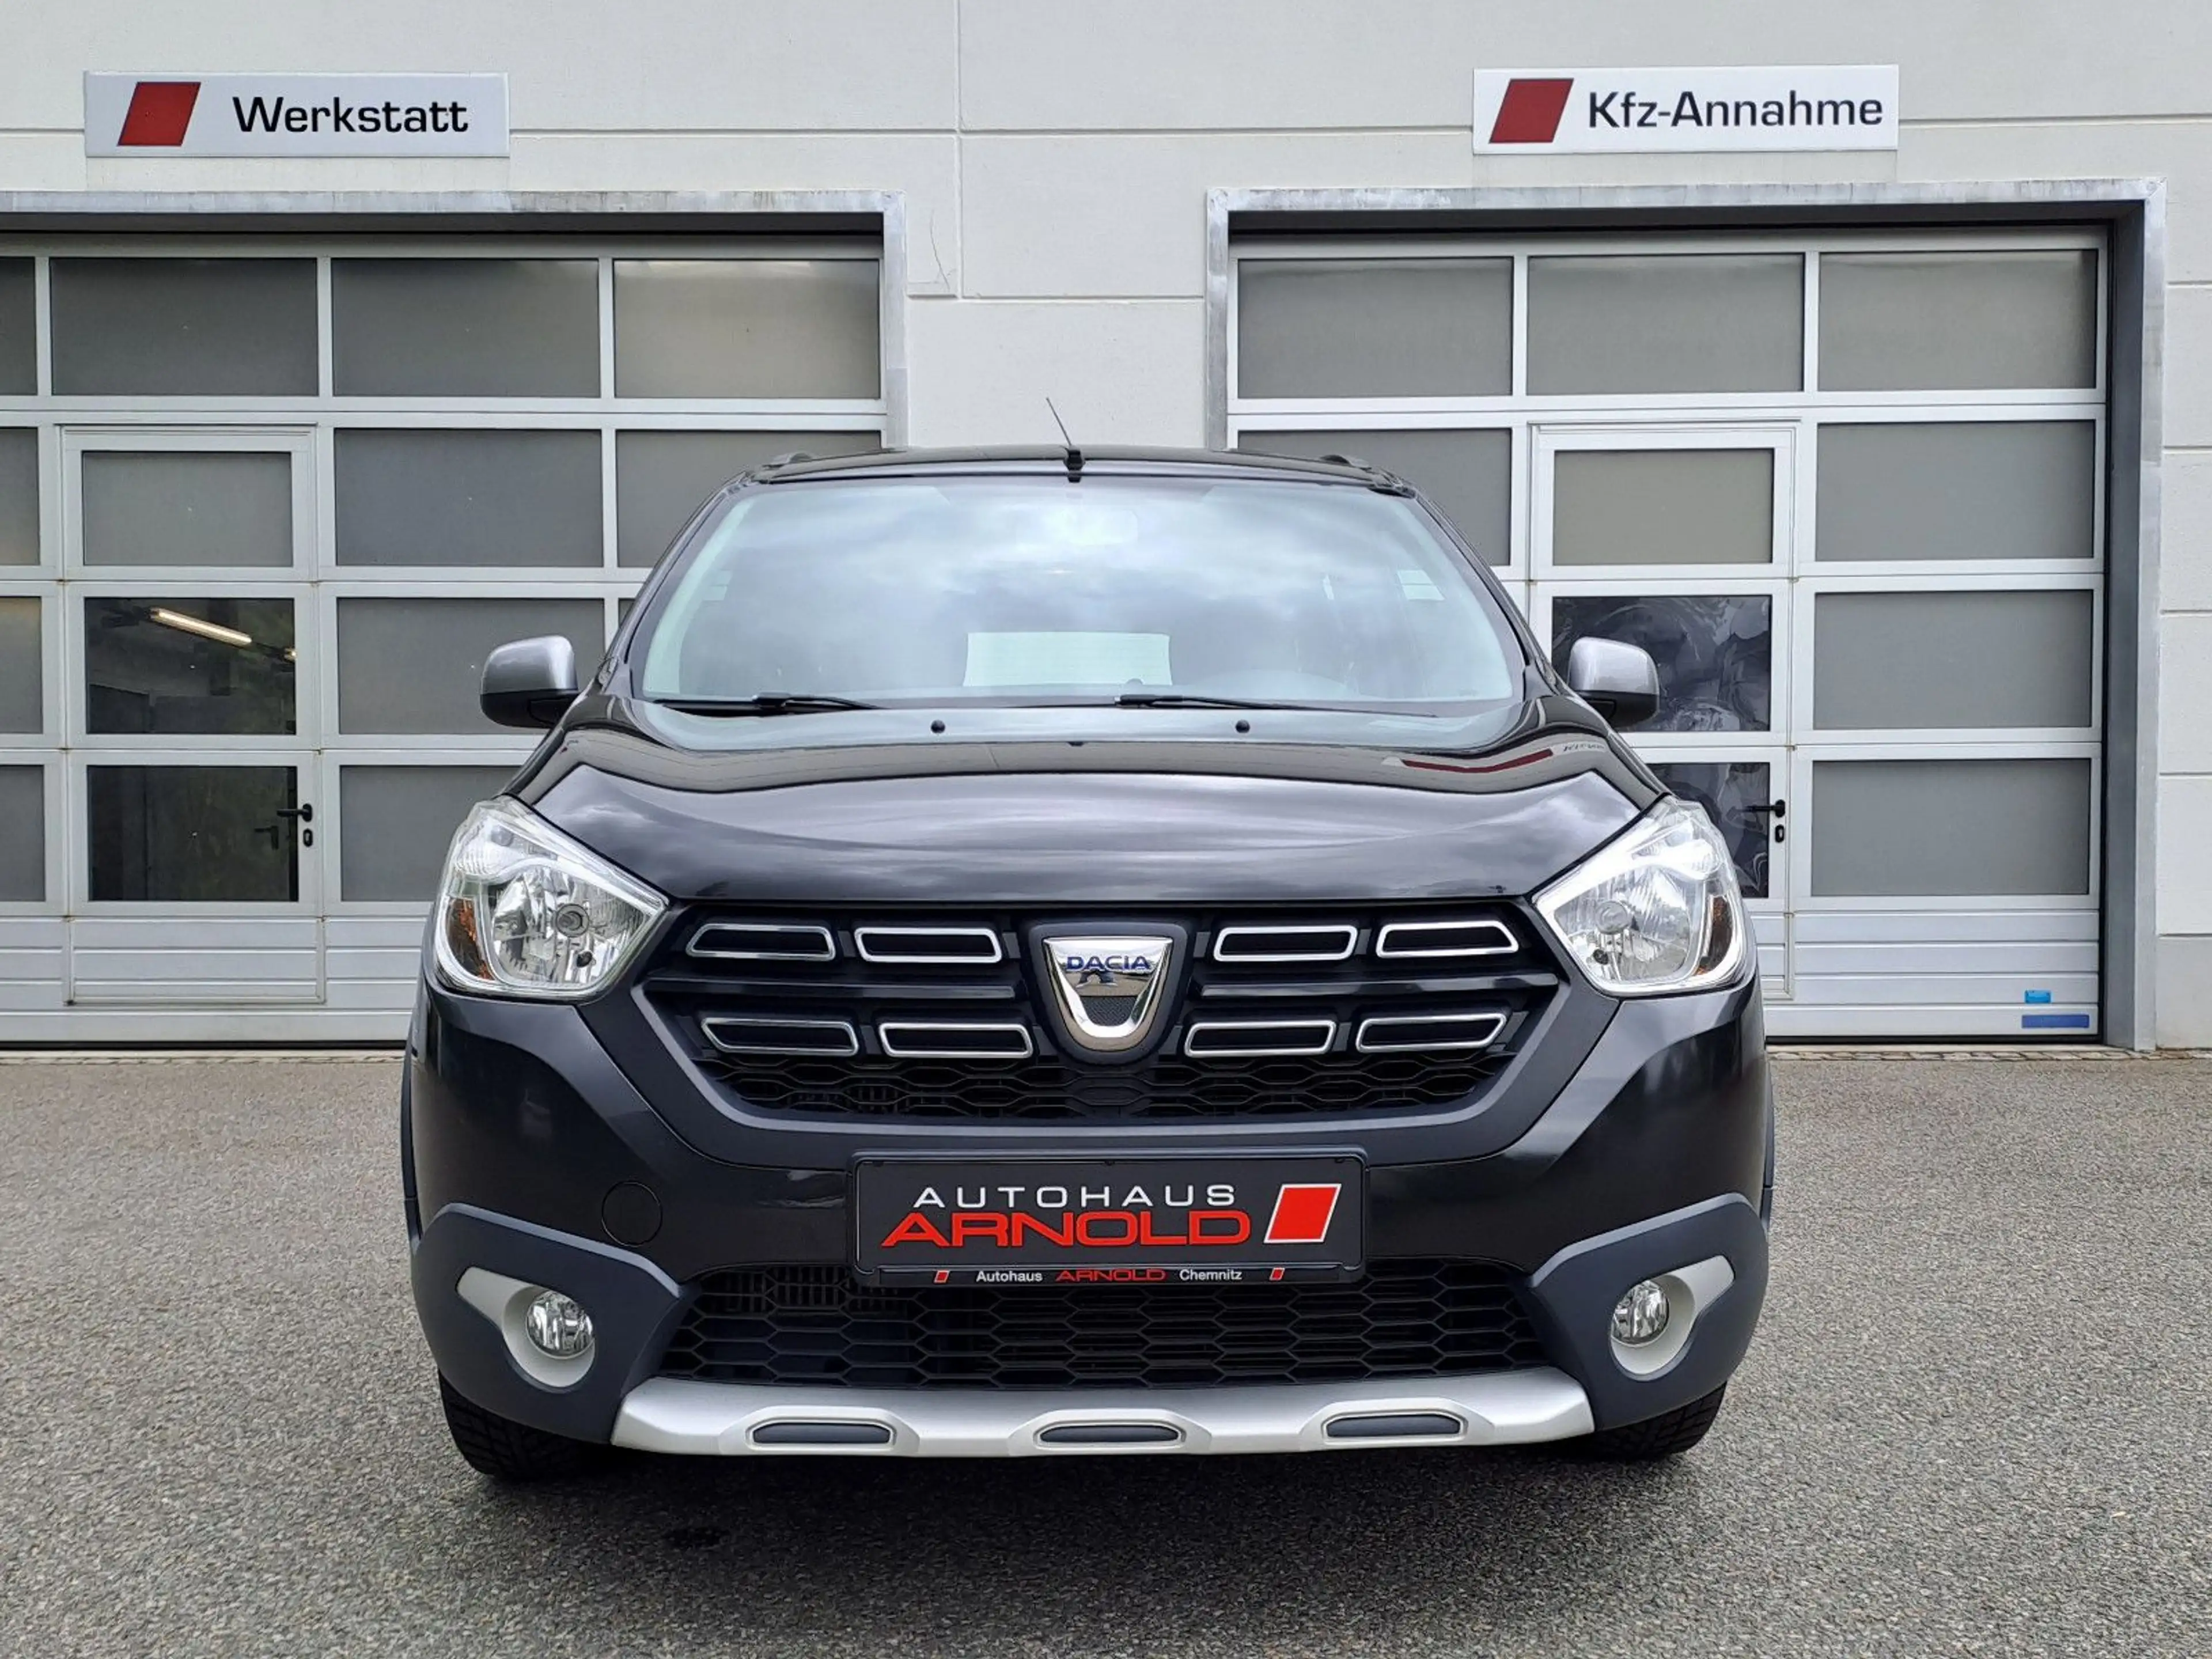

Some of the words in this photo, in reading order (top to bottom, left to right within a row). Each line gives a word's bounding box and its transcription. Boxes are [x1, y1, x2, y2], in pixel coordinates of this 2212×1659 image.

[232, 96, 468, 132] Werkstatt
[1588, 90, 1883, 127] Kfz-Annahme
[1066, 956, 1150, 970] DACIA
[913, 1184, 1235, 1208] AUTOHAUS
[881, 1210, 1251, 1248] ARNOLD
[976, 1270, 1043, 1282] Autohaus
[1055, 1269, 1167, 1282] ARNOLD
[1179, 1268, 1243, 1282] Chemnitz
